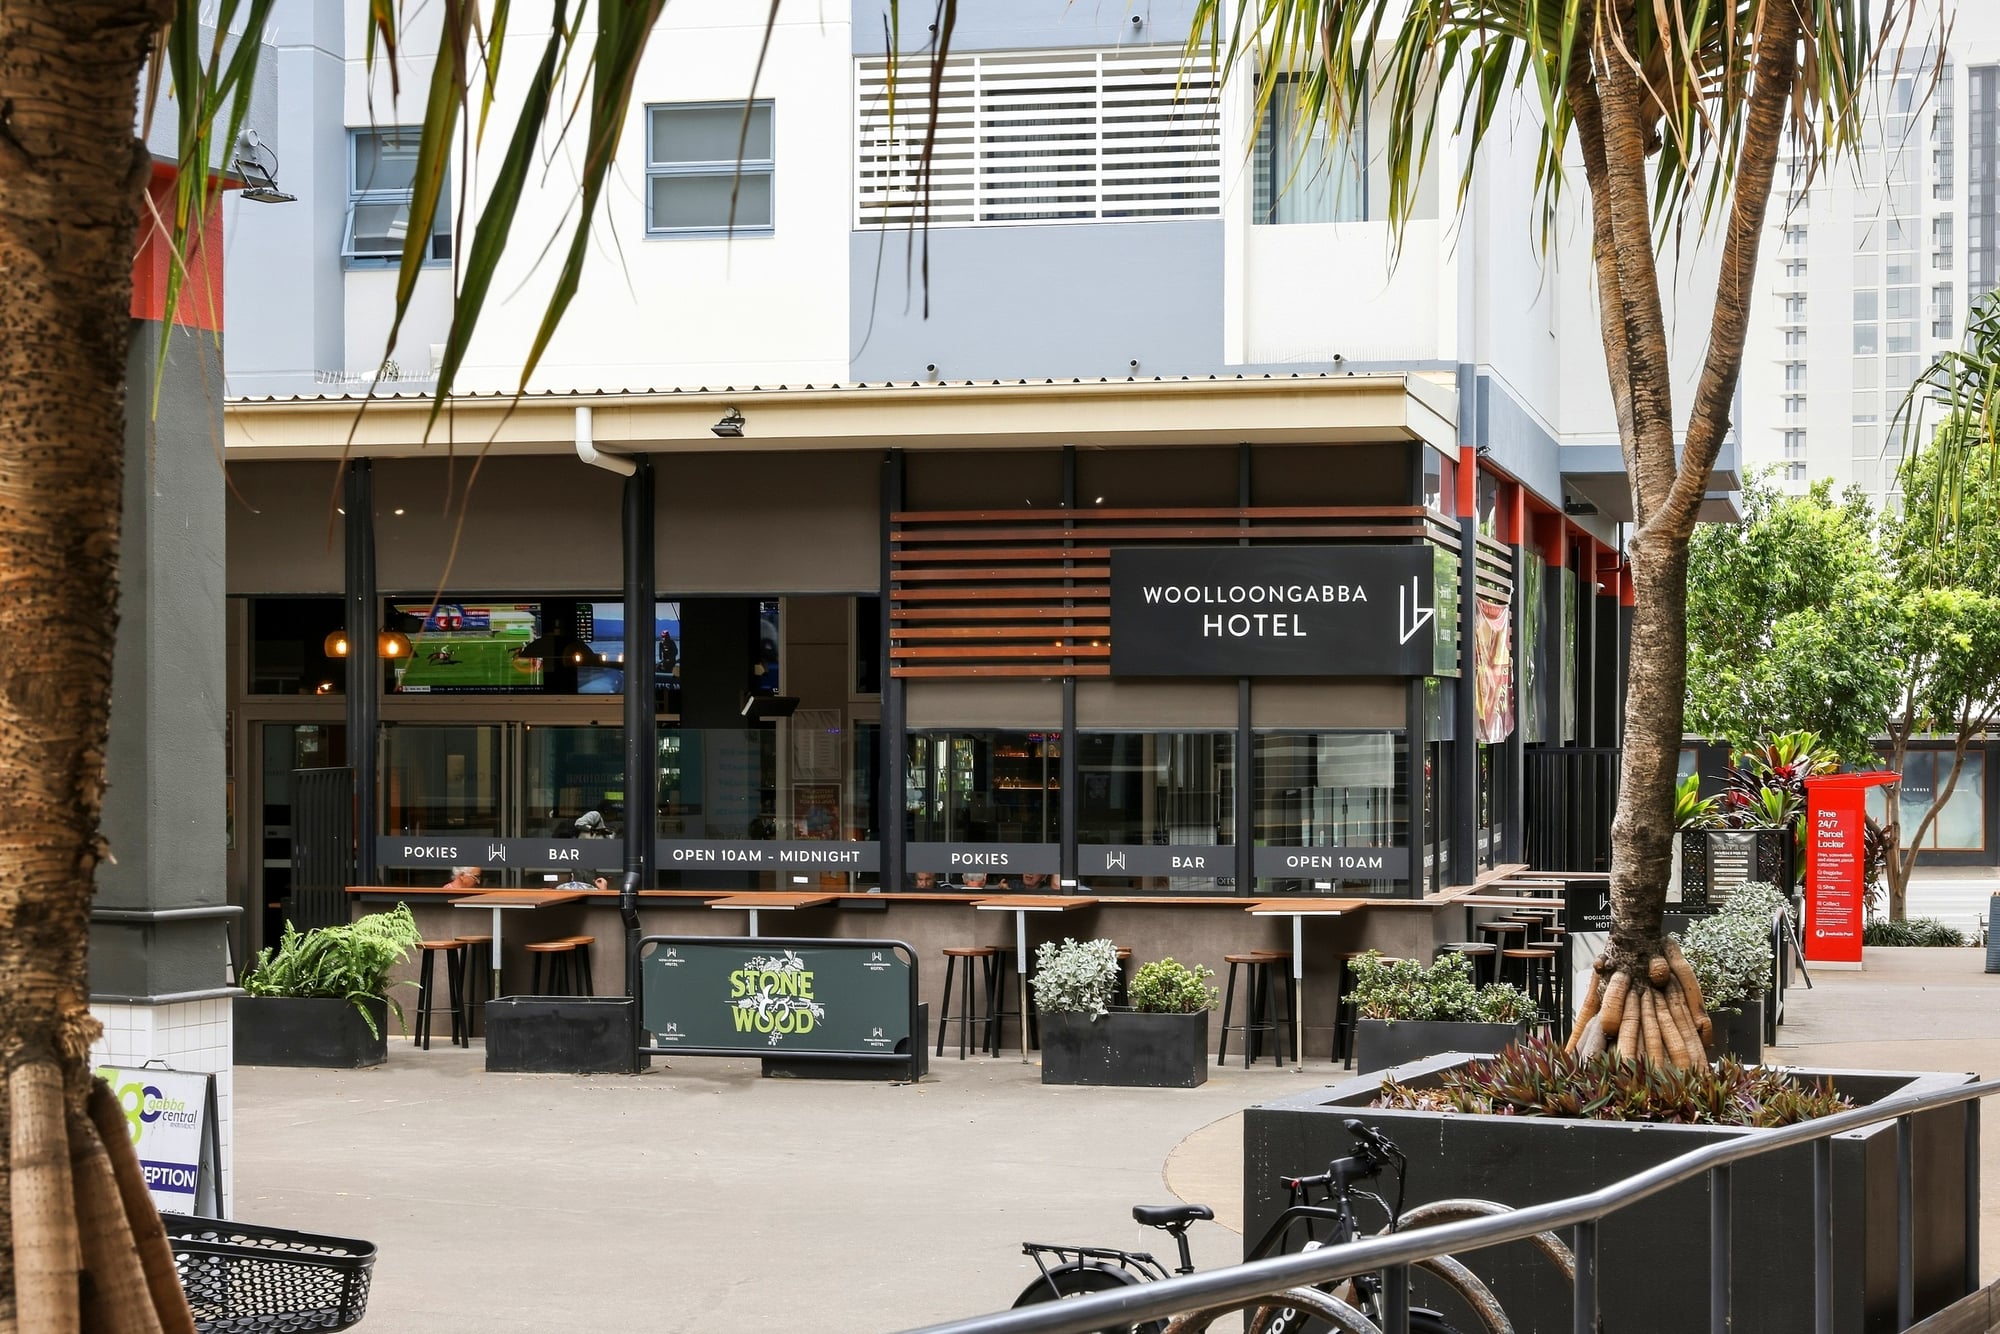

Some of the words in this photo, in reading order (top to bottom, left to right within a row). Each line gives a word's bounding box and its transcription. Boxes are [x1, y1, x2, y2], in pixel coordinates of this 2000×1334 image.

[1143, 584, 1368, 604] WOOLLOONGABBA
[1203, 613, 1307, 637] HOTEL
[1817, 809, 1837, 818] Free
[1817, 819, 1839, 829] 24/7
[1817, 829, 1844, 838] Parcel
[1817, 839, 1846, 848] Locker
[404, 846, 458, 859] POKIES
[549, 848, 580, 861] BAR
[672, 849, 715, 861] OPEN
[721, 849, 762, 862] 10AM
[780, 850, 860, 863] MIDNIGHT
[951, 852, 1009, 865] POKIES
[1172, 856, 1205, 869] BAR
[1286, 855, 1332, 868] OPEN
[1338, 856, 1383, 869] 10AM
[1595, 921, 1610, 929] HOT
[730, 970, 814, 999] STONE
[731, 1005, 814, 1034] WOOD
[148, 1098, 185, 1113] gabba
[162, 1110, 198, 1124] central
[141, 1166, 196, 1188] EPTION
